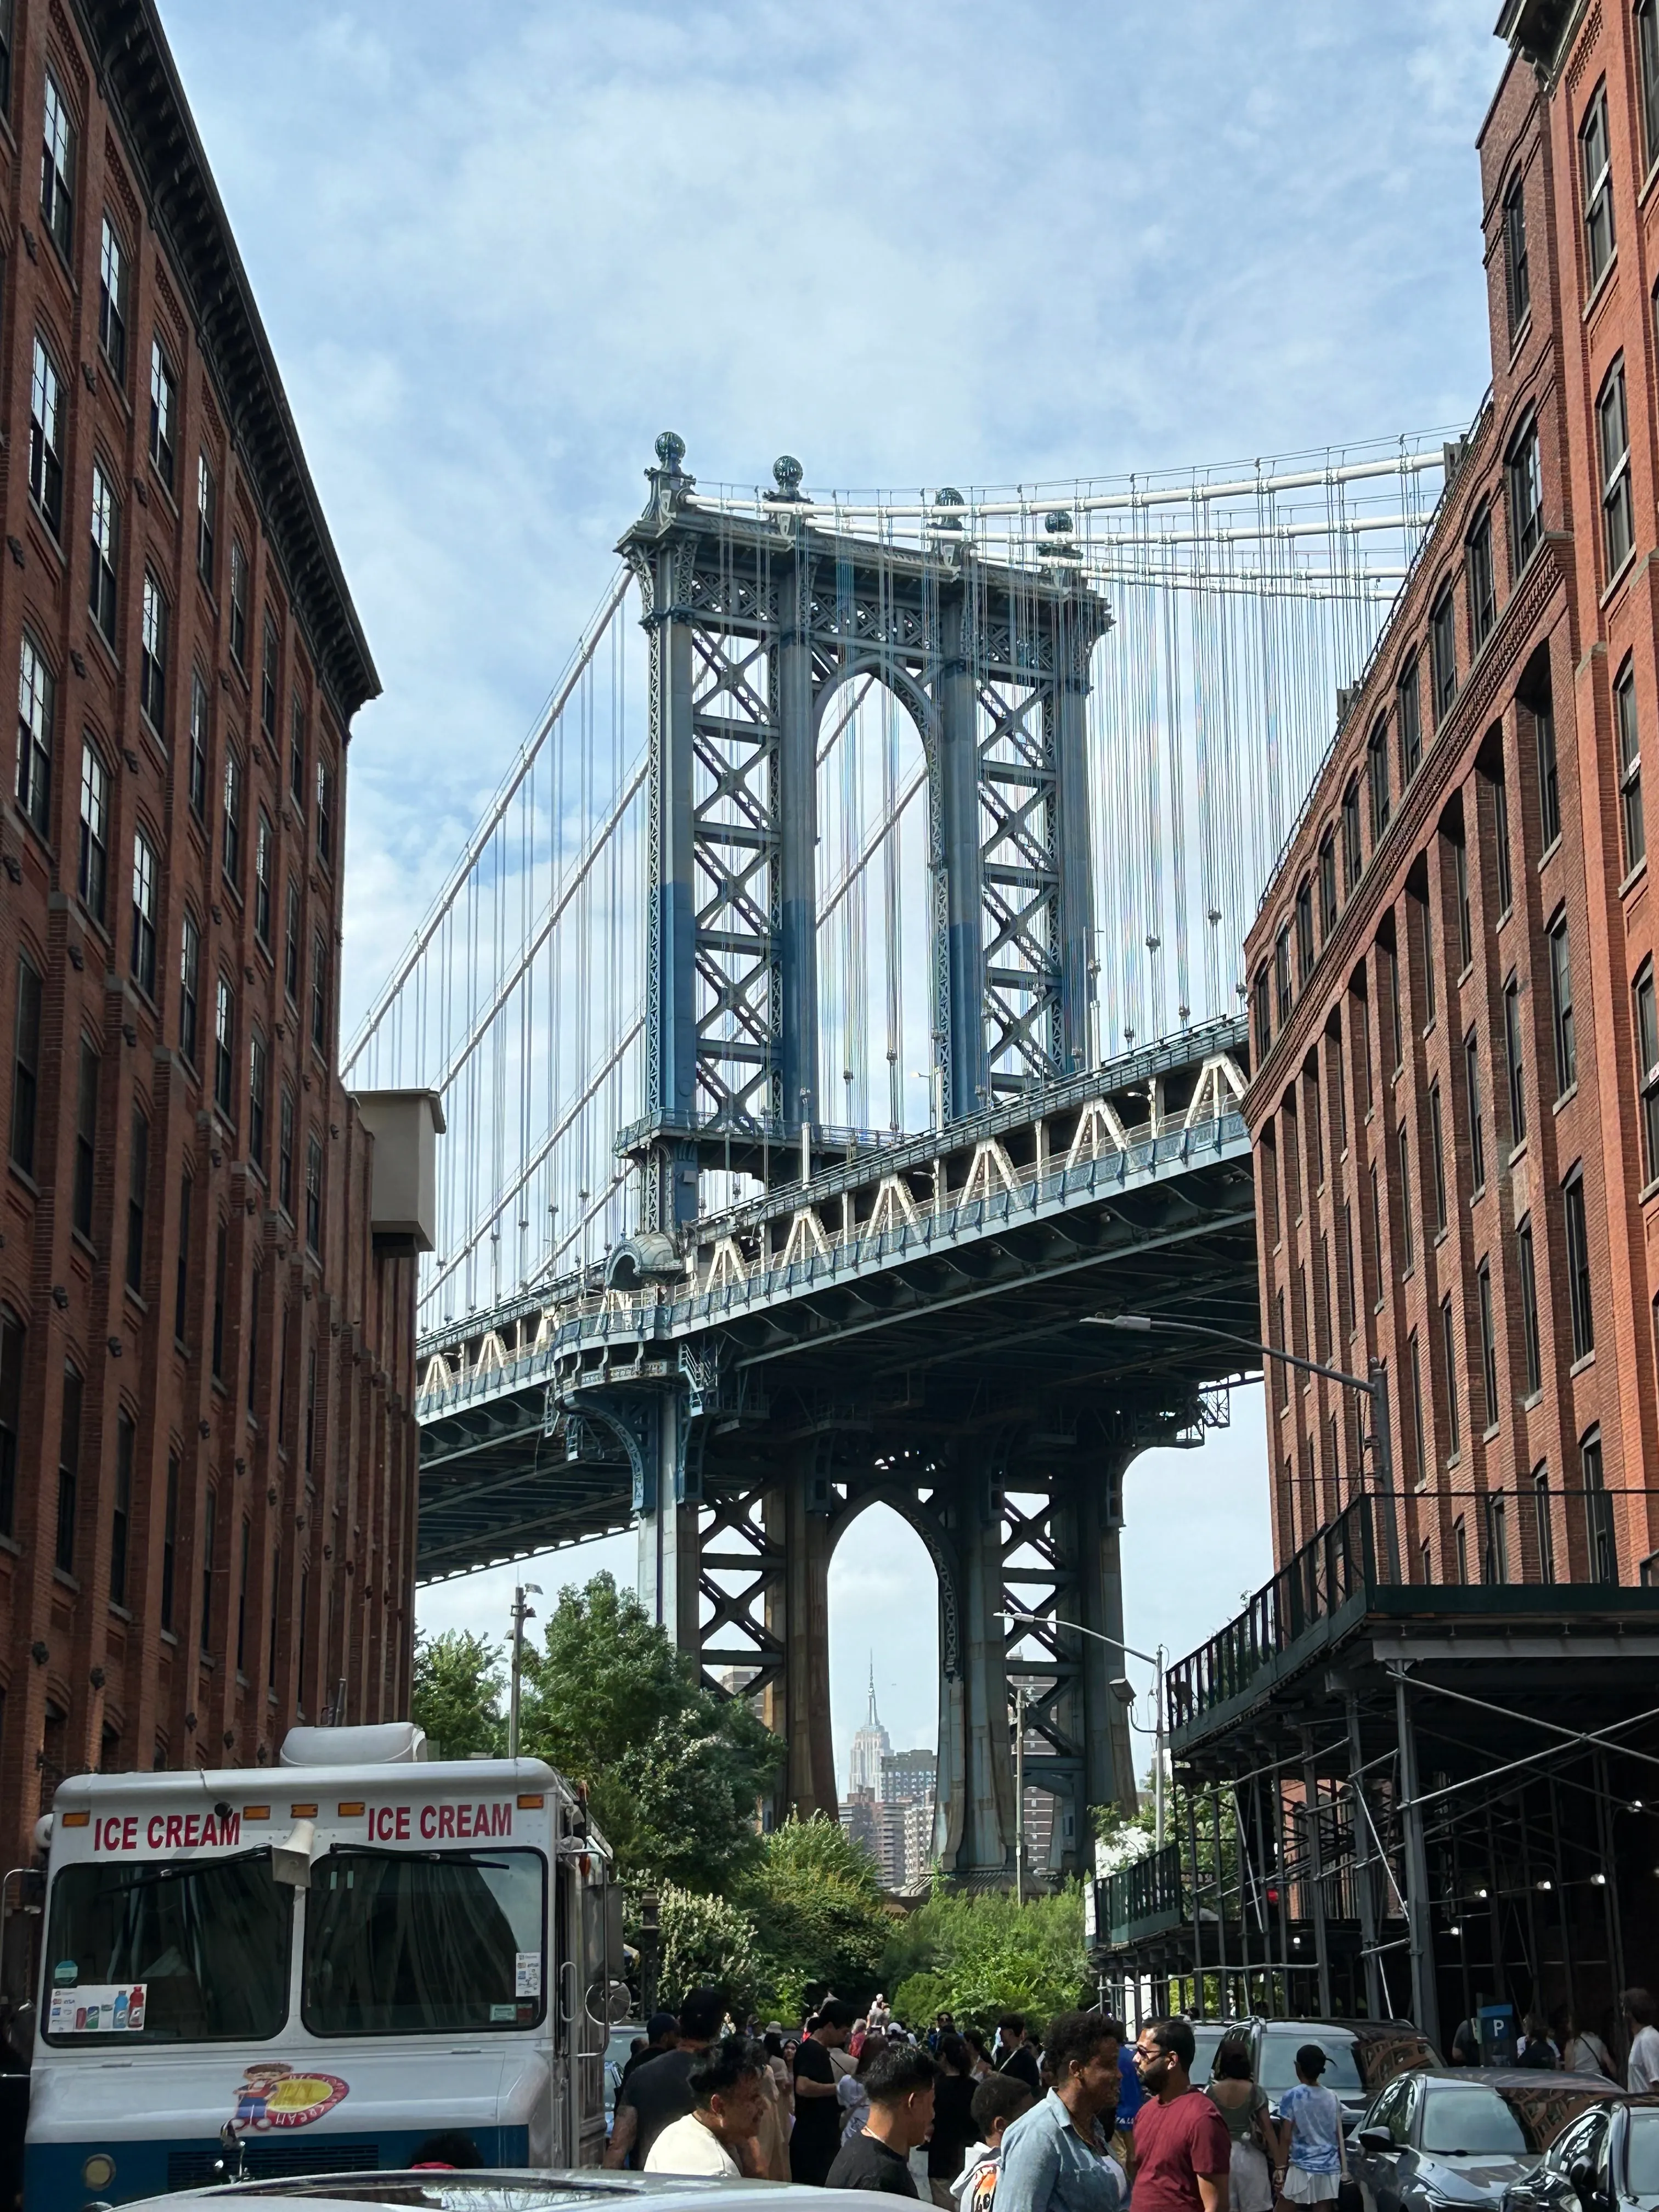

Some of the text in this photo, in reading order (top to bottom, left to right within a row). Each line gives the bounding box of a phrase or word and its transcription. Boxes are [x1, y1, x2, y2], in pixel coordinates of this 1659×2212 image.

[94, 1812, 241, 1852] ICE CREAM
[368, 1803, 512, 1841] ICE CREAM
[1493, 2019, 1504, 2037] P
